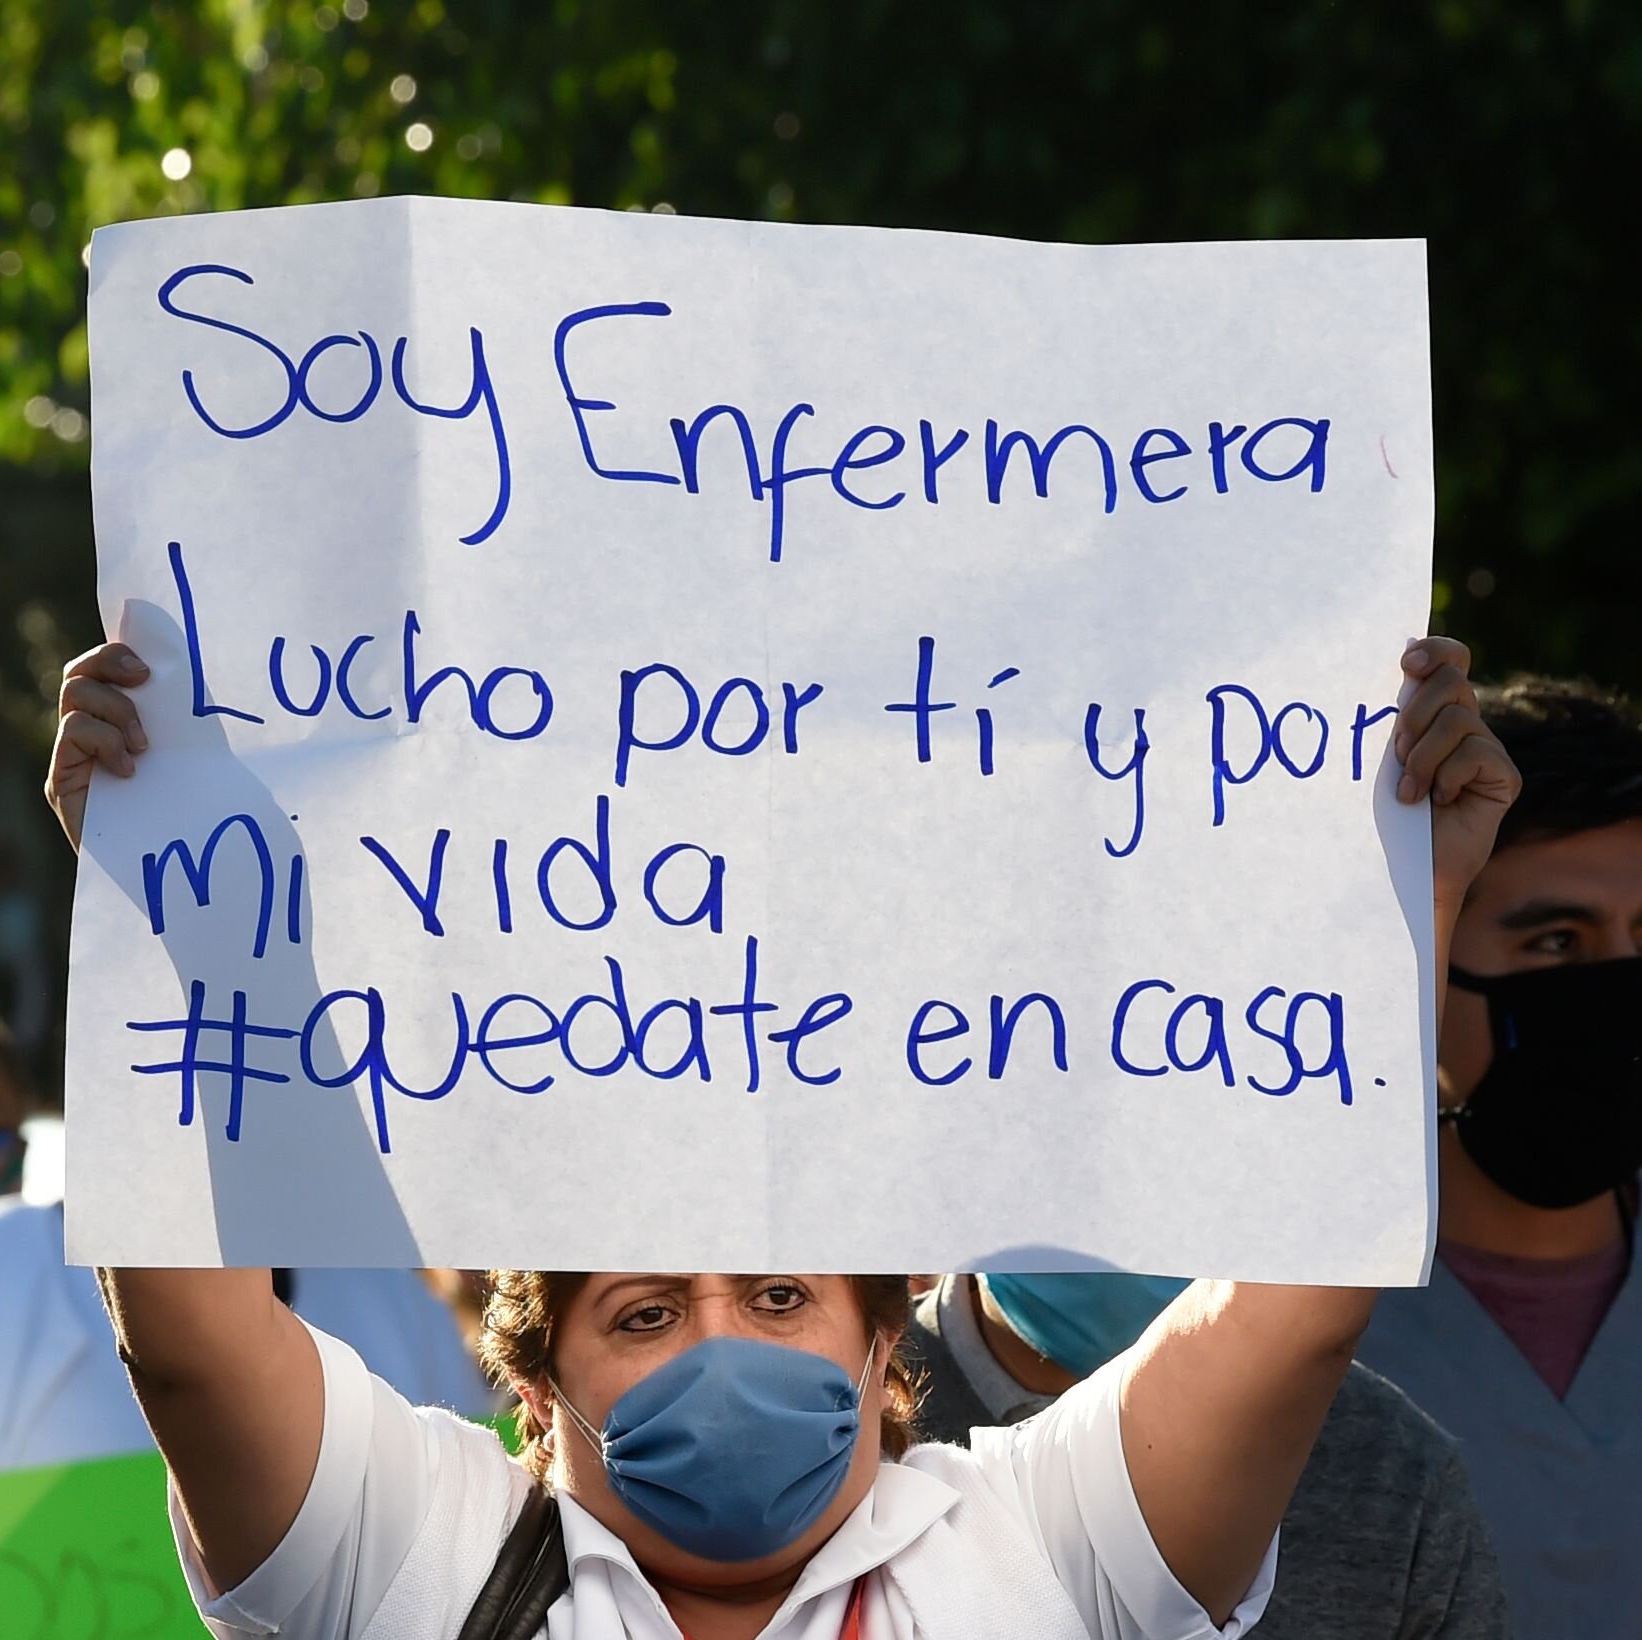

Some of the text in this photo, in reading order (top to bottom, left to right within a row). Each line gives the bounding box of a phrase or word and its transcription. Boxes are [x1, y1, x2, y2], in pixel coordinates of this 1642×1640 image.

[160, 266, 1329, 561] Soy Enfermera
[169, 544, 1399, 858] Lucho por tí y por
[364, 796, 726, 936] vida
[126, 938, 1389, 1154] #quedate en casa.
